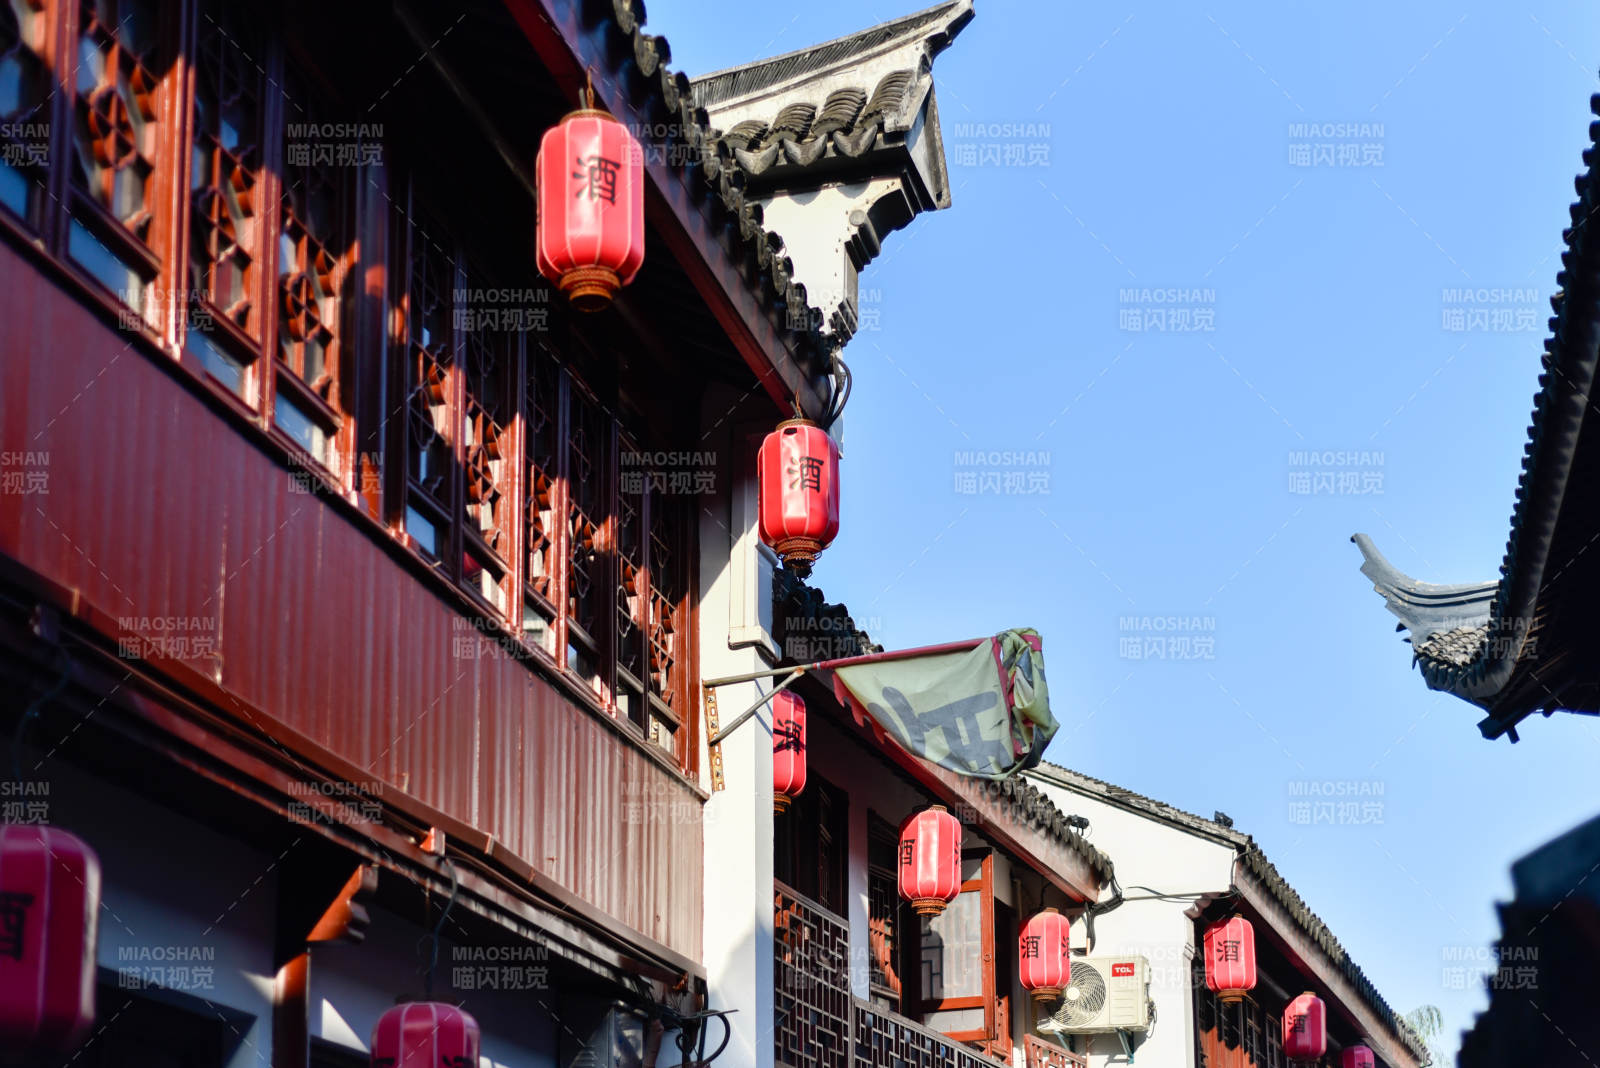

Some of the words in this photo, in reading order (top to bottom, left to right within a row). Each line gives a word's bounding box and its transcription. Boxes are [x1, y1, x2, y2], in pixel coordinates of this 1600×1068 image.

[573, 155, 621, 206] 酒
[788, 456, 824, 493] 酒
[1021, 935, 1041, 959] 酒
[1216, 940, 1240, 962] 酒
[1114, 966, 1132, 974] TCL
[1287, 1014, 1307, 1033] 酒
